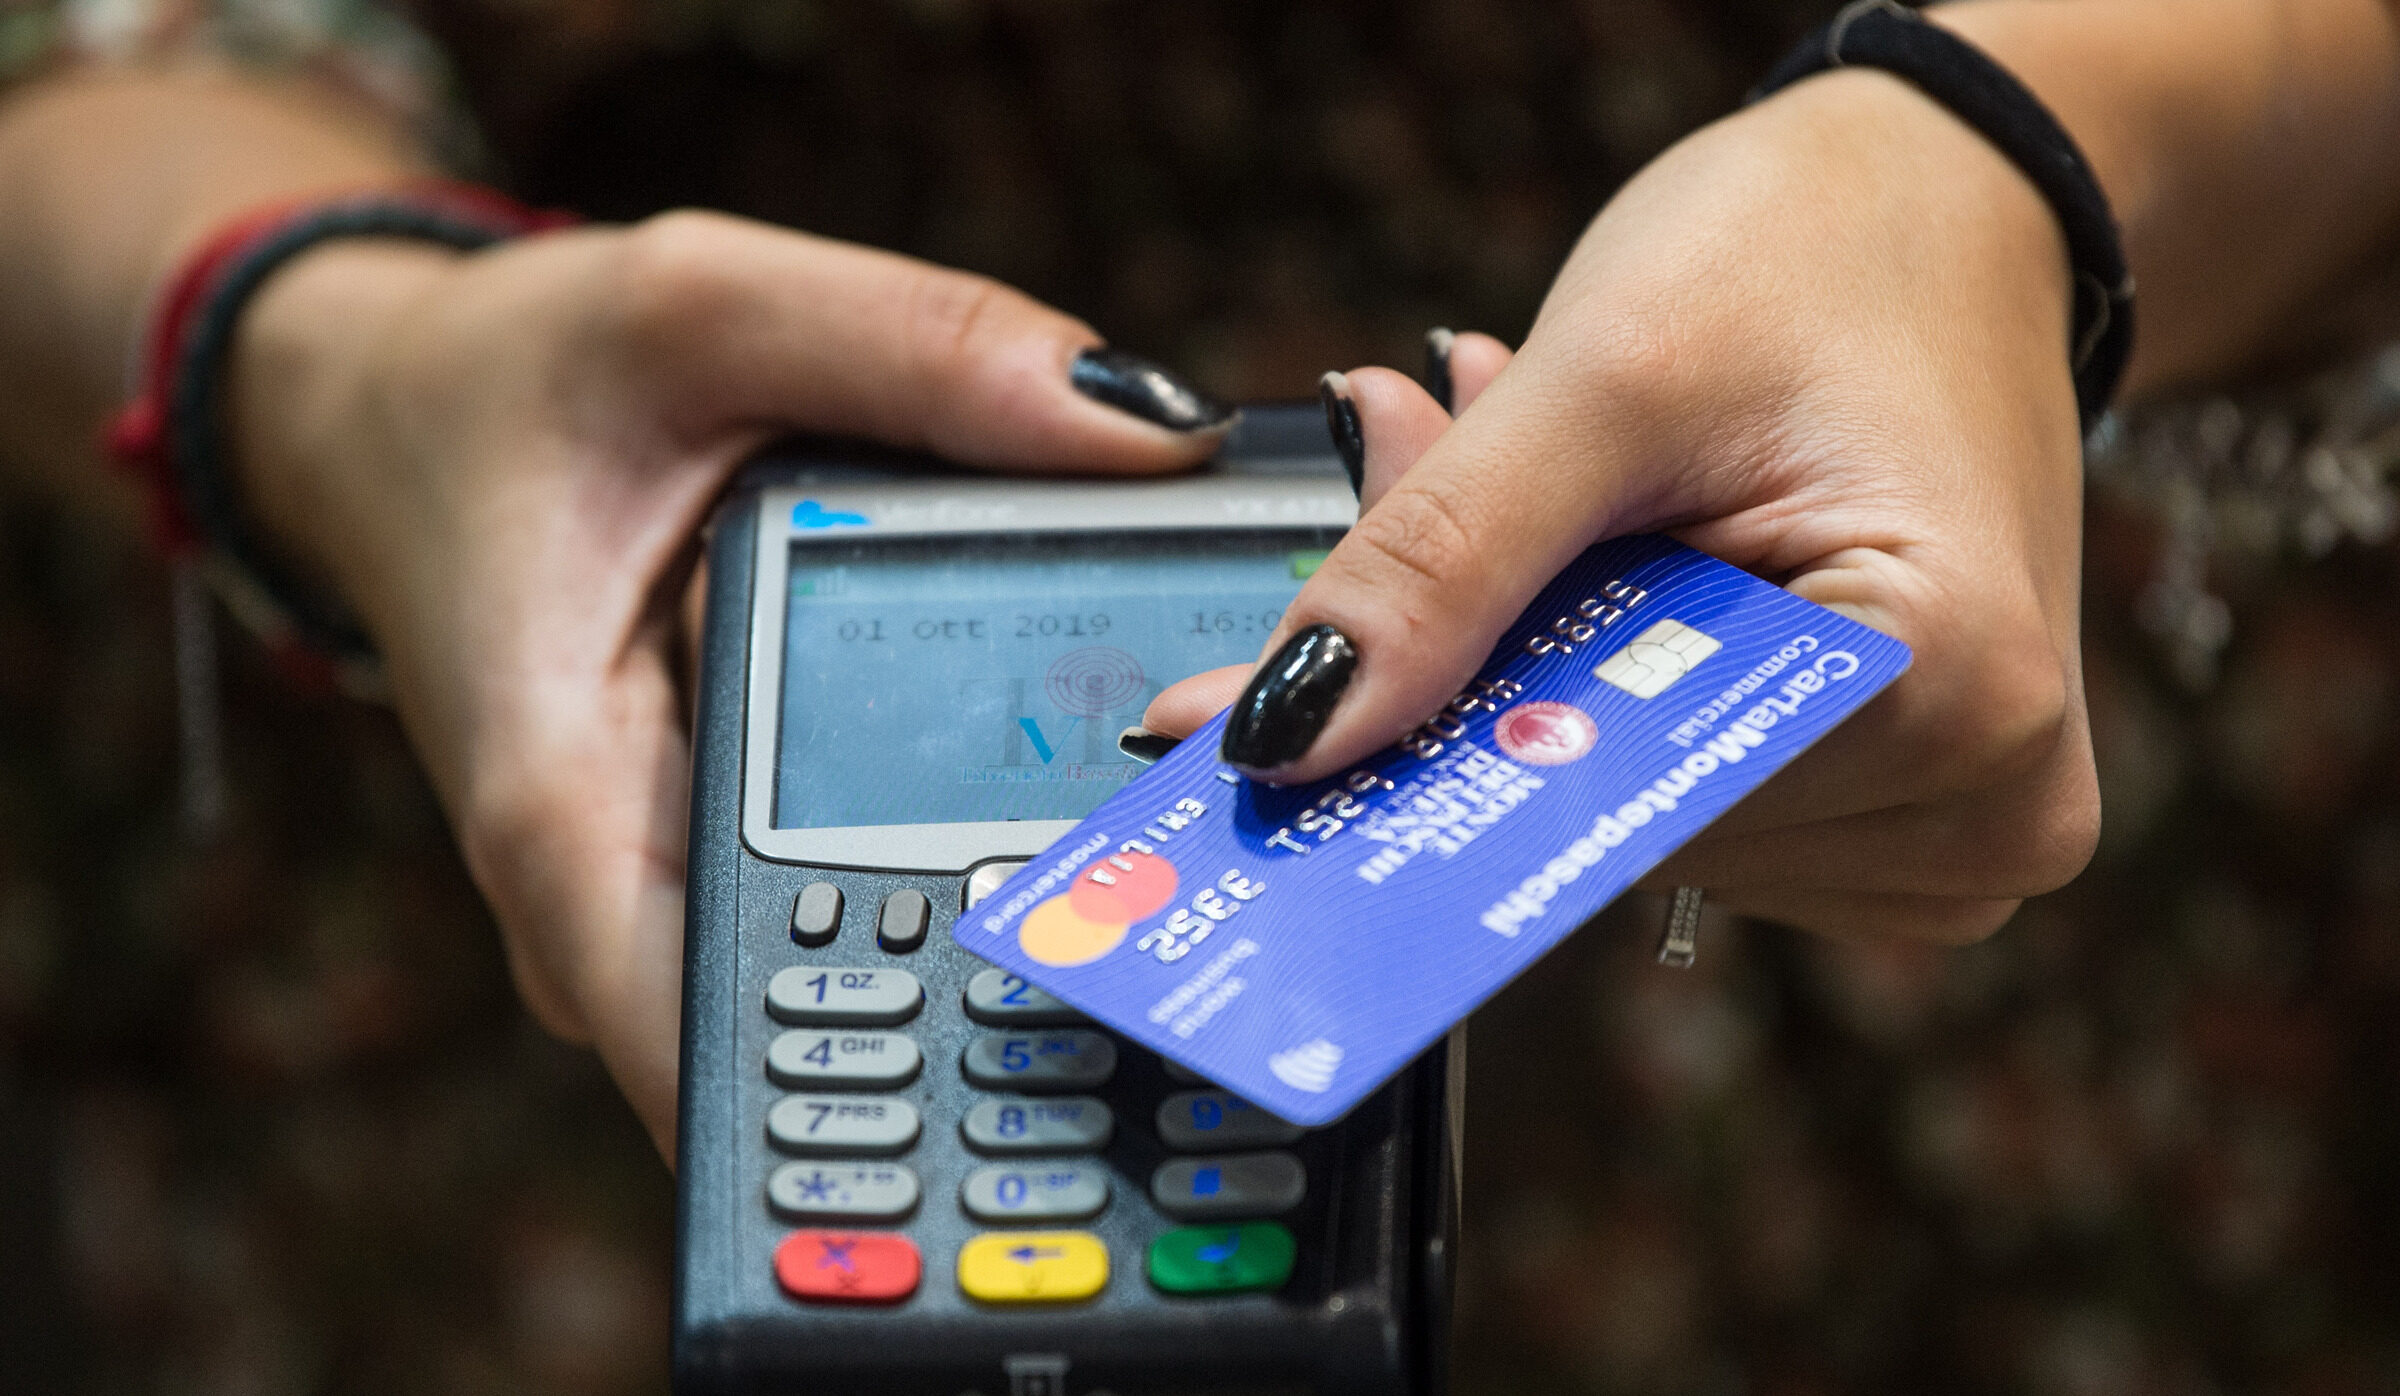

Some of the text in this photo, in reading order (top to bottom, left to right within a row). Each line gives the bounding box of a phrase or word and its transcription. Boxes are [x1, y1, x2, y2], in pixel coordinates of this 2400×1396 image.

[838, 619, 887, 642] 01
[1014, 613, 1112, 637] 2019
[1189, 609, 1283, 634] 16:0
[1527, 578, 1649, 656] 5586
[1664, 633, 1820, 748] Commercial
[1480, 649, 1861, 937] CartaMontepaschi
[1263, 772, 1397, 863] 6251
[1432, 775, 1545, 855] MONTE
[1081, 796, 1206, 890] EMILIA
[981, 831, 1111, 935] mastercard
[1135, 867, 1267, 962] 3352
[804, 973, 829, 1004] 1
[1001, 974, 1031, 1006] 2
[802, 1037, 885, 1068] 4 GHI
[1001, 1040, 1032, 1072] 5
[806, 1102, 888, 1133] 7 PRS
[998, 1105, 1027, 1139] 8
[1191, 1098, 1223, 1131] 9
[994, 1173, 1028, 1209] 0
